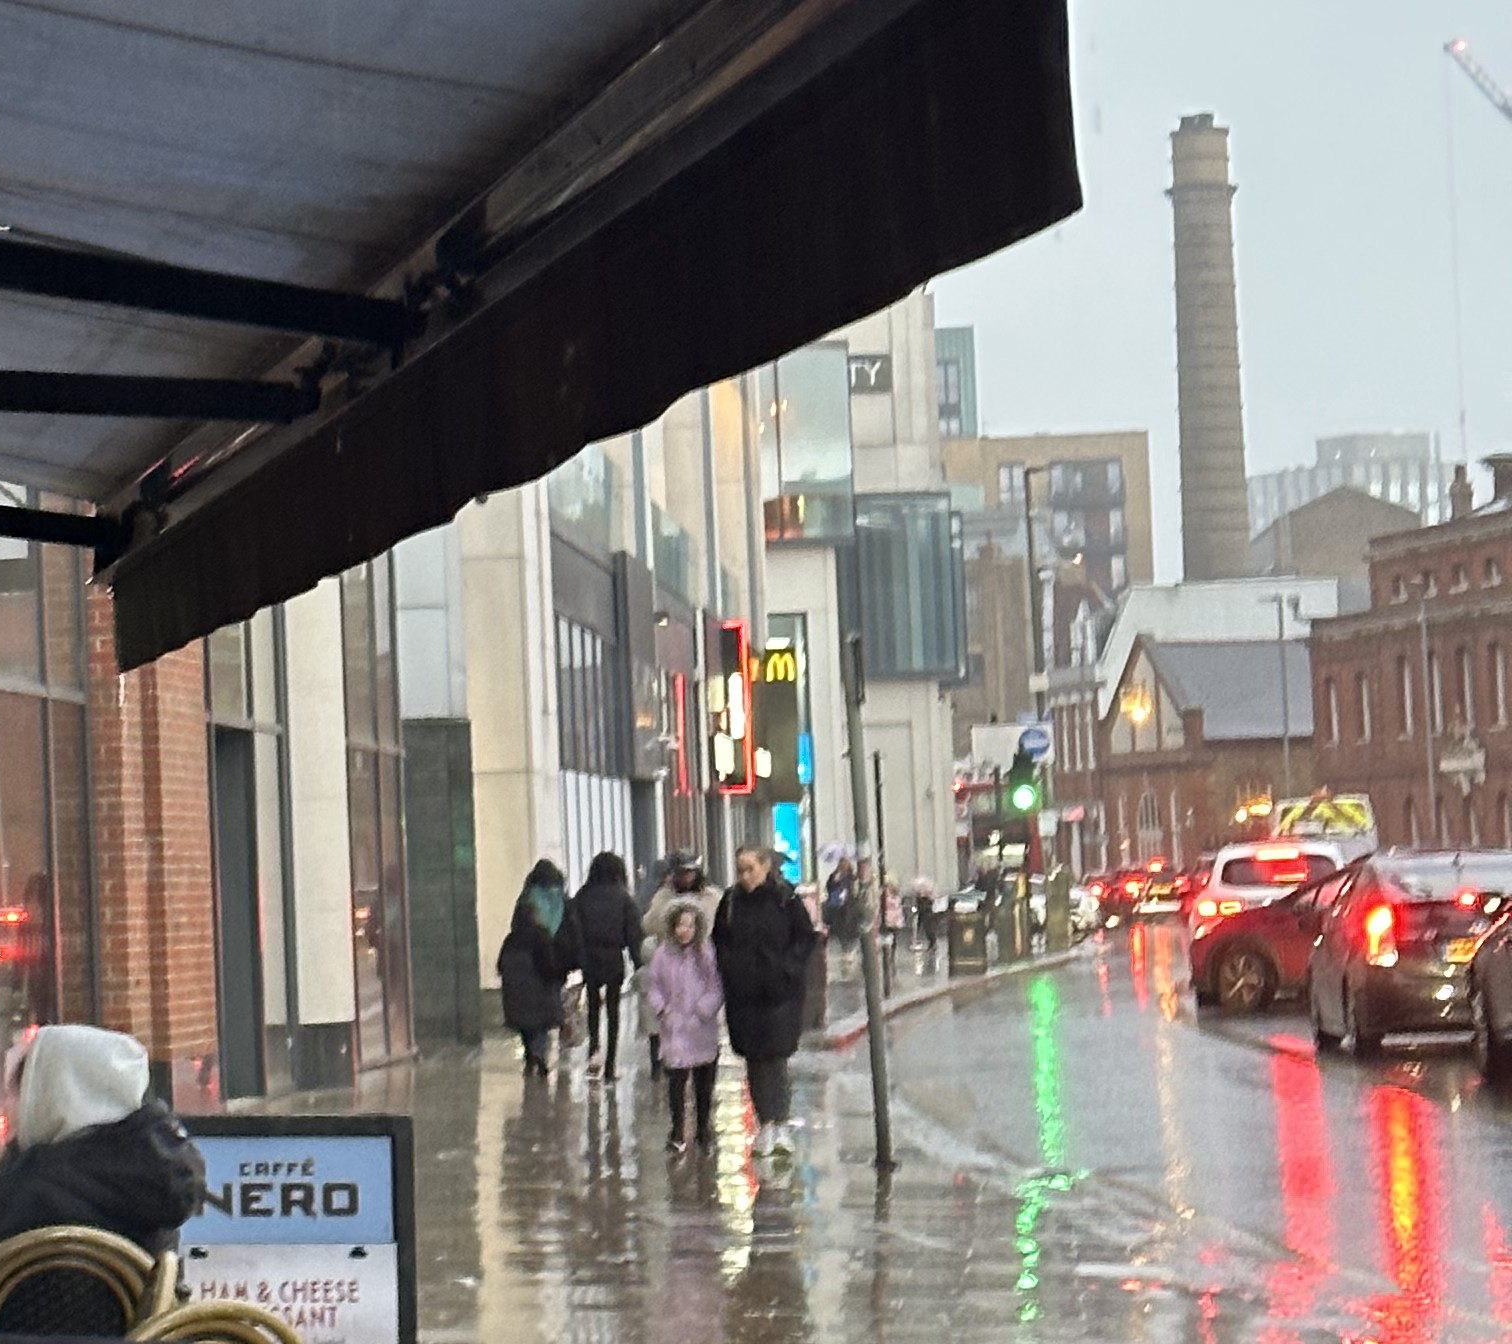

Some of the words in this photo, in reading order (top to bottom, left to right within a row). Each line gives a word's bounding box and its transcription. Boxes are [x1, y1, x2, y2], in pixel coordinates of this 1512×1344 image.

[195, 1182, 360, 1219] NERO
[200, 1280, 249, 1302] HAM
[257, 1281, 272, 1302] &
[278, 1279, 360, 1304] CHEESE
